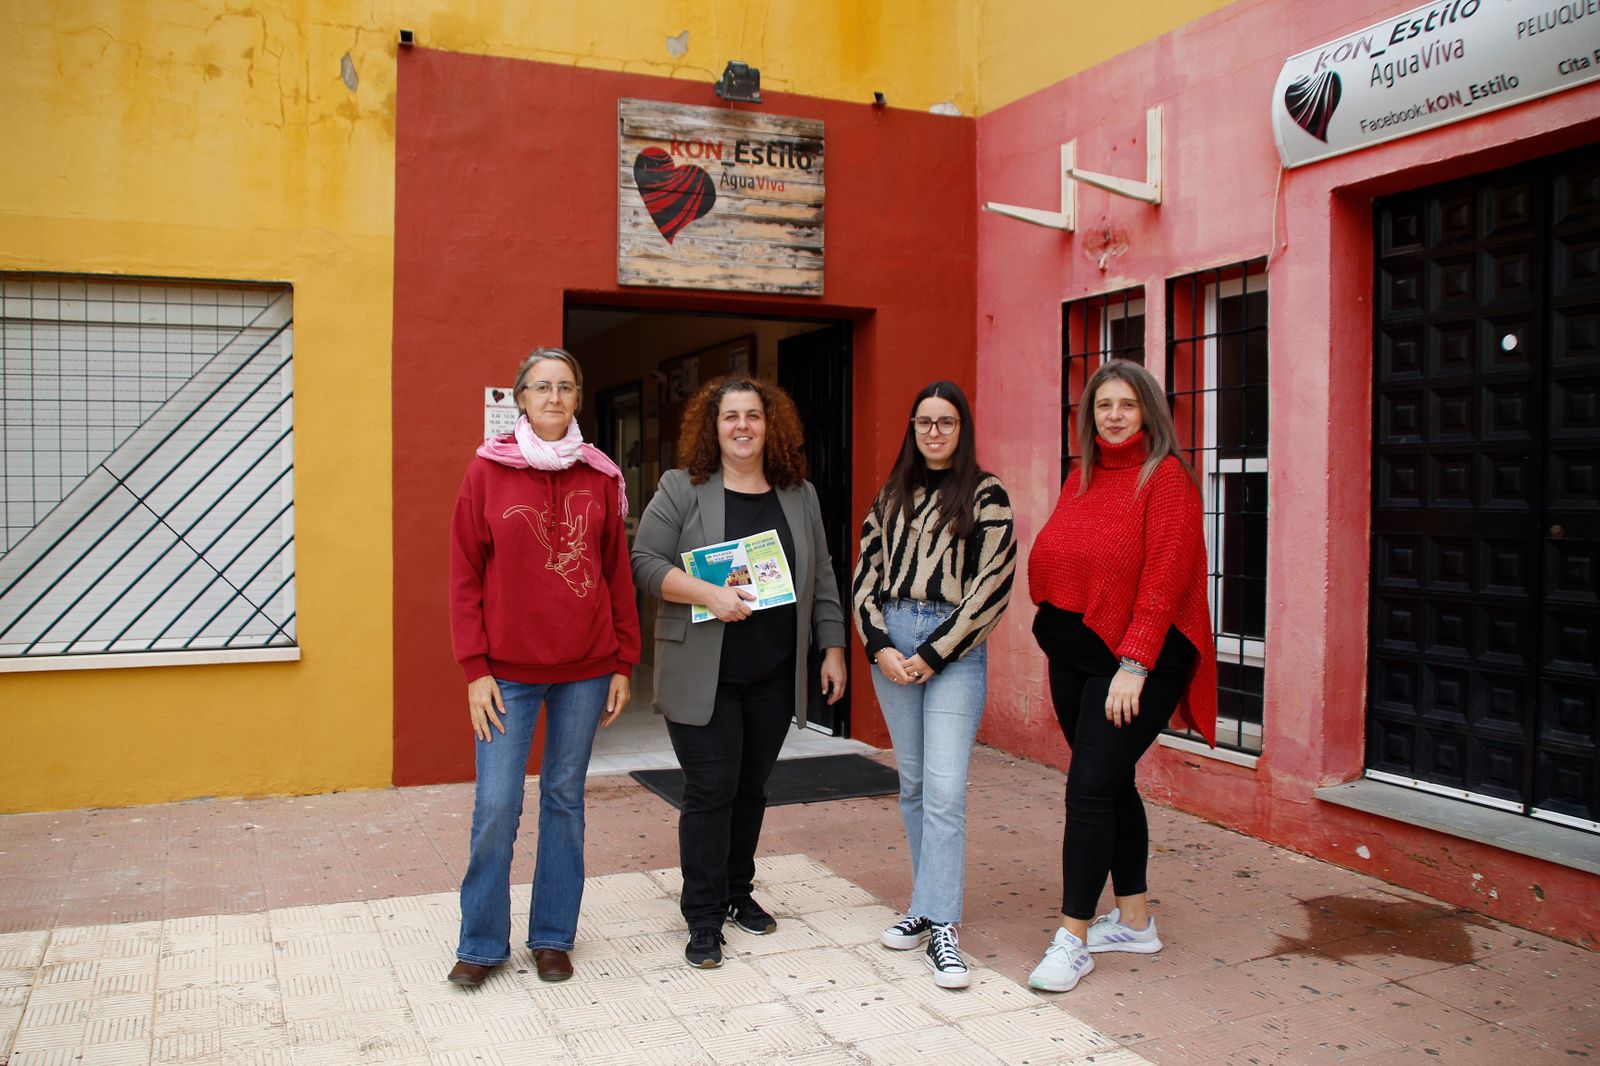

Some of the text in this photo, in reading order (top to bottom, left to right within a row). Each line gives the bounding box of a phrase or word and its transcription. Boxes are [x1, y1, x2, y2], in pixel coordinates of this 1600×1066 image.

[1517, 0, 1600, 40] PELUQUE
[1369, 38, 1465, 88] AguaViva
[1557, 57, 1591, 76] Cita
[719, 171, 785, 192] AguaViva
